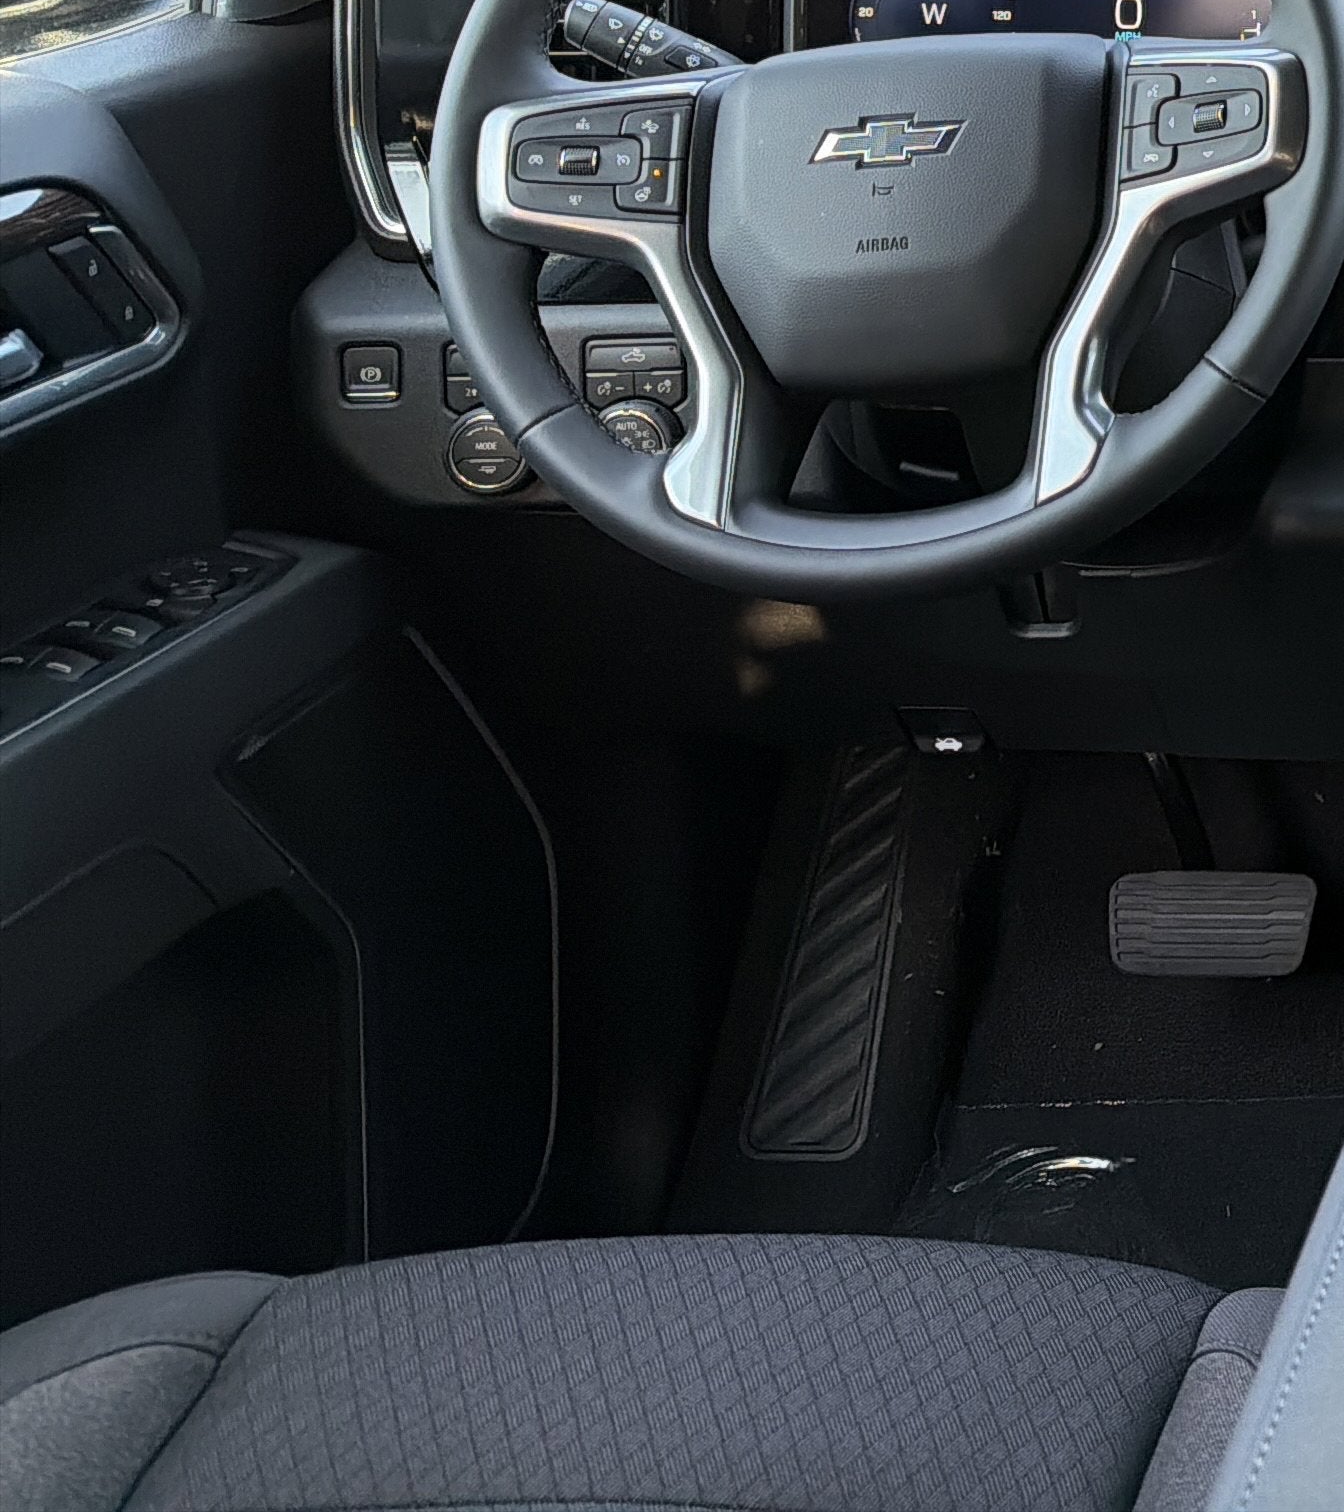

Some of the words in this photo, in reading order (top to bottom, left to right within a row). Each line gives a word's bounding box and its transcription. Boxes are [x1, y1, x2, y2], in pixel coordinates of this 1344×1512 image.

[859, 7, 874, 17] 20
[922, 3, 948, 25] W
[992, 11, 1012, 20] 120
[1114, 31, 1142, 42] MPH
[855, 236, 909, 254] AIRBAG
[616, 422, 638, 431] AUTO
[475, 441, 497, 451] MODE
